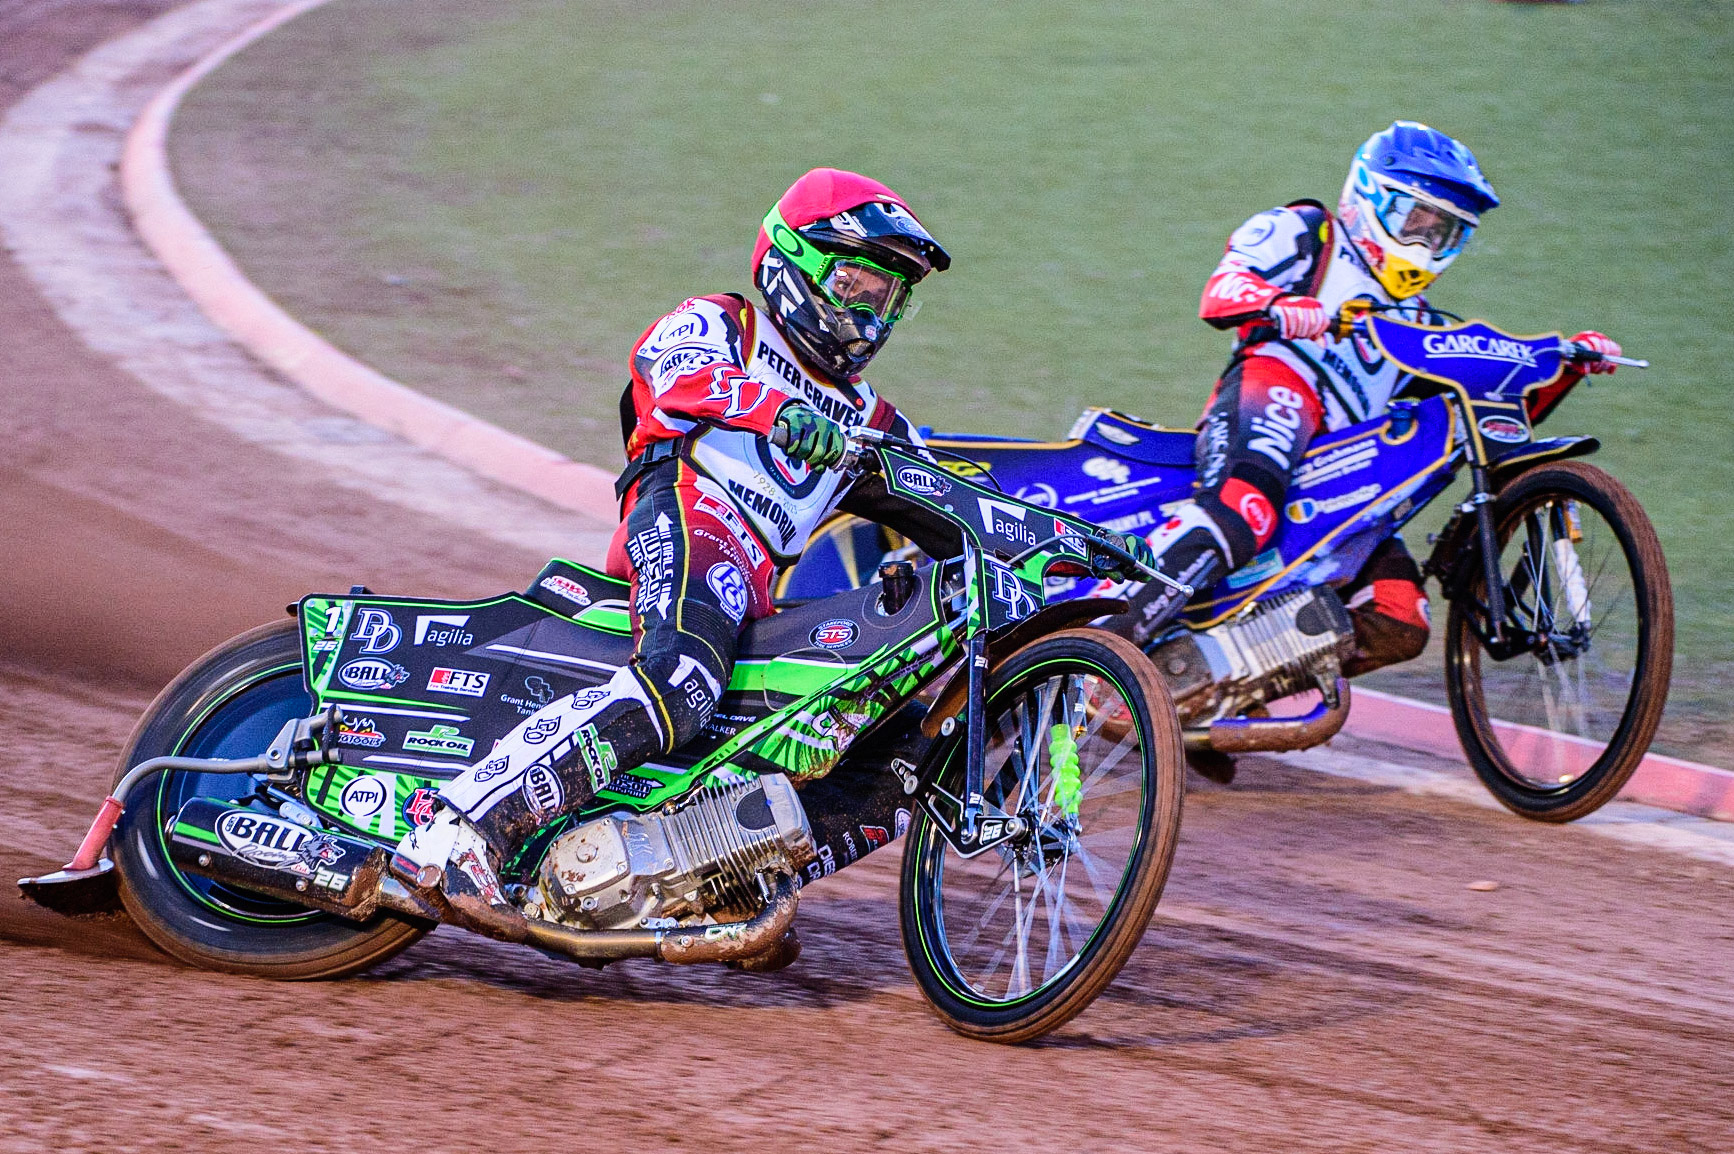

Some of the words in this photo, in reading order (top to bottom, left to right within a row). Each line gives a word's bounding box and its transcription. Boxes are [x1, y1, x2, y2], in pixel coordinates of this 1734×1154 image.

[757, 340, 801, 389] PETER
[1247, 386, 1304, 470] Nice
[753, 473, 776, 496] 1928
[728, 479, 797, 551] MEMORIAL
[694, 529, 728, 546] Grant
[725, 511, 762, 562] FTS
[995, 518, 1036, 546] agilia
[324, 606, 342, 634] 1
[313, 640, 338, 651] 26
[427, 627, 473, 647] agilia
[817, 629, 850, 640] STS
[449, 671, 487, 689] FTS
[501, 694, 524, 706] Grant
[684, 678, 714, 729] agilia
[407, 736, 441, 748] ROCK
[445, 740, 470, 751] OIL
[580, 729, 601, 766] ROCK
[347, 789, 379, 805] ATPI
[230, 816, 307, 853] BALL
[983, 823, 1003, 841] 26
[314, 869, 351, 892] 26
